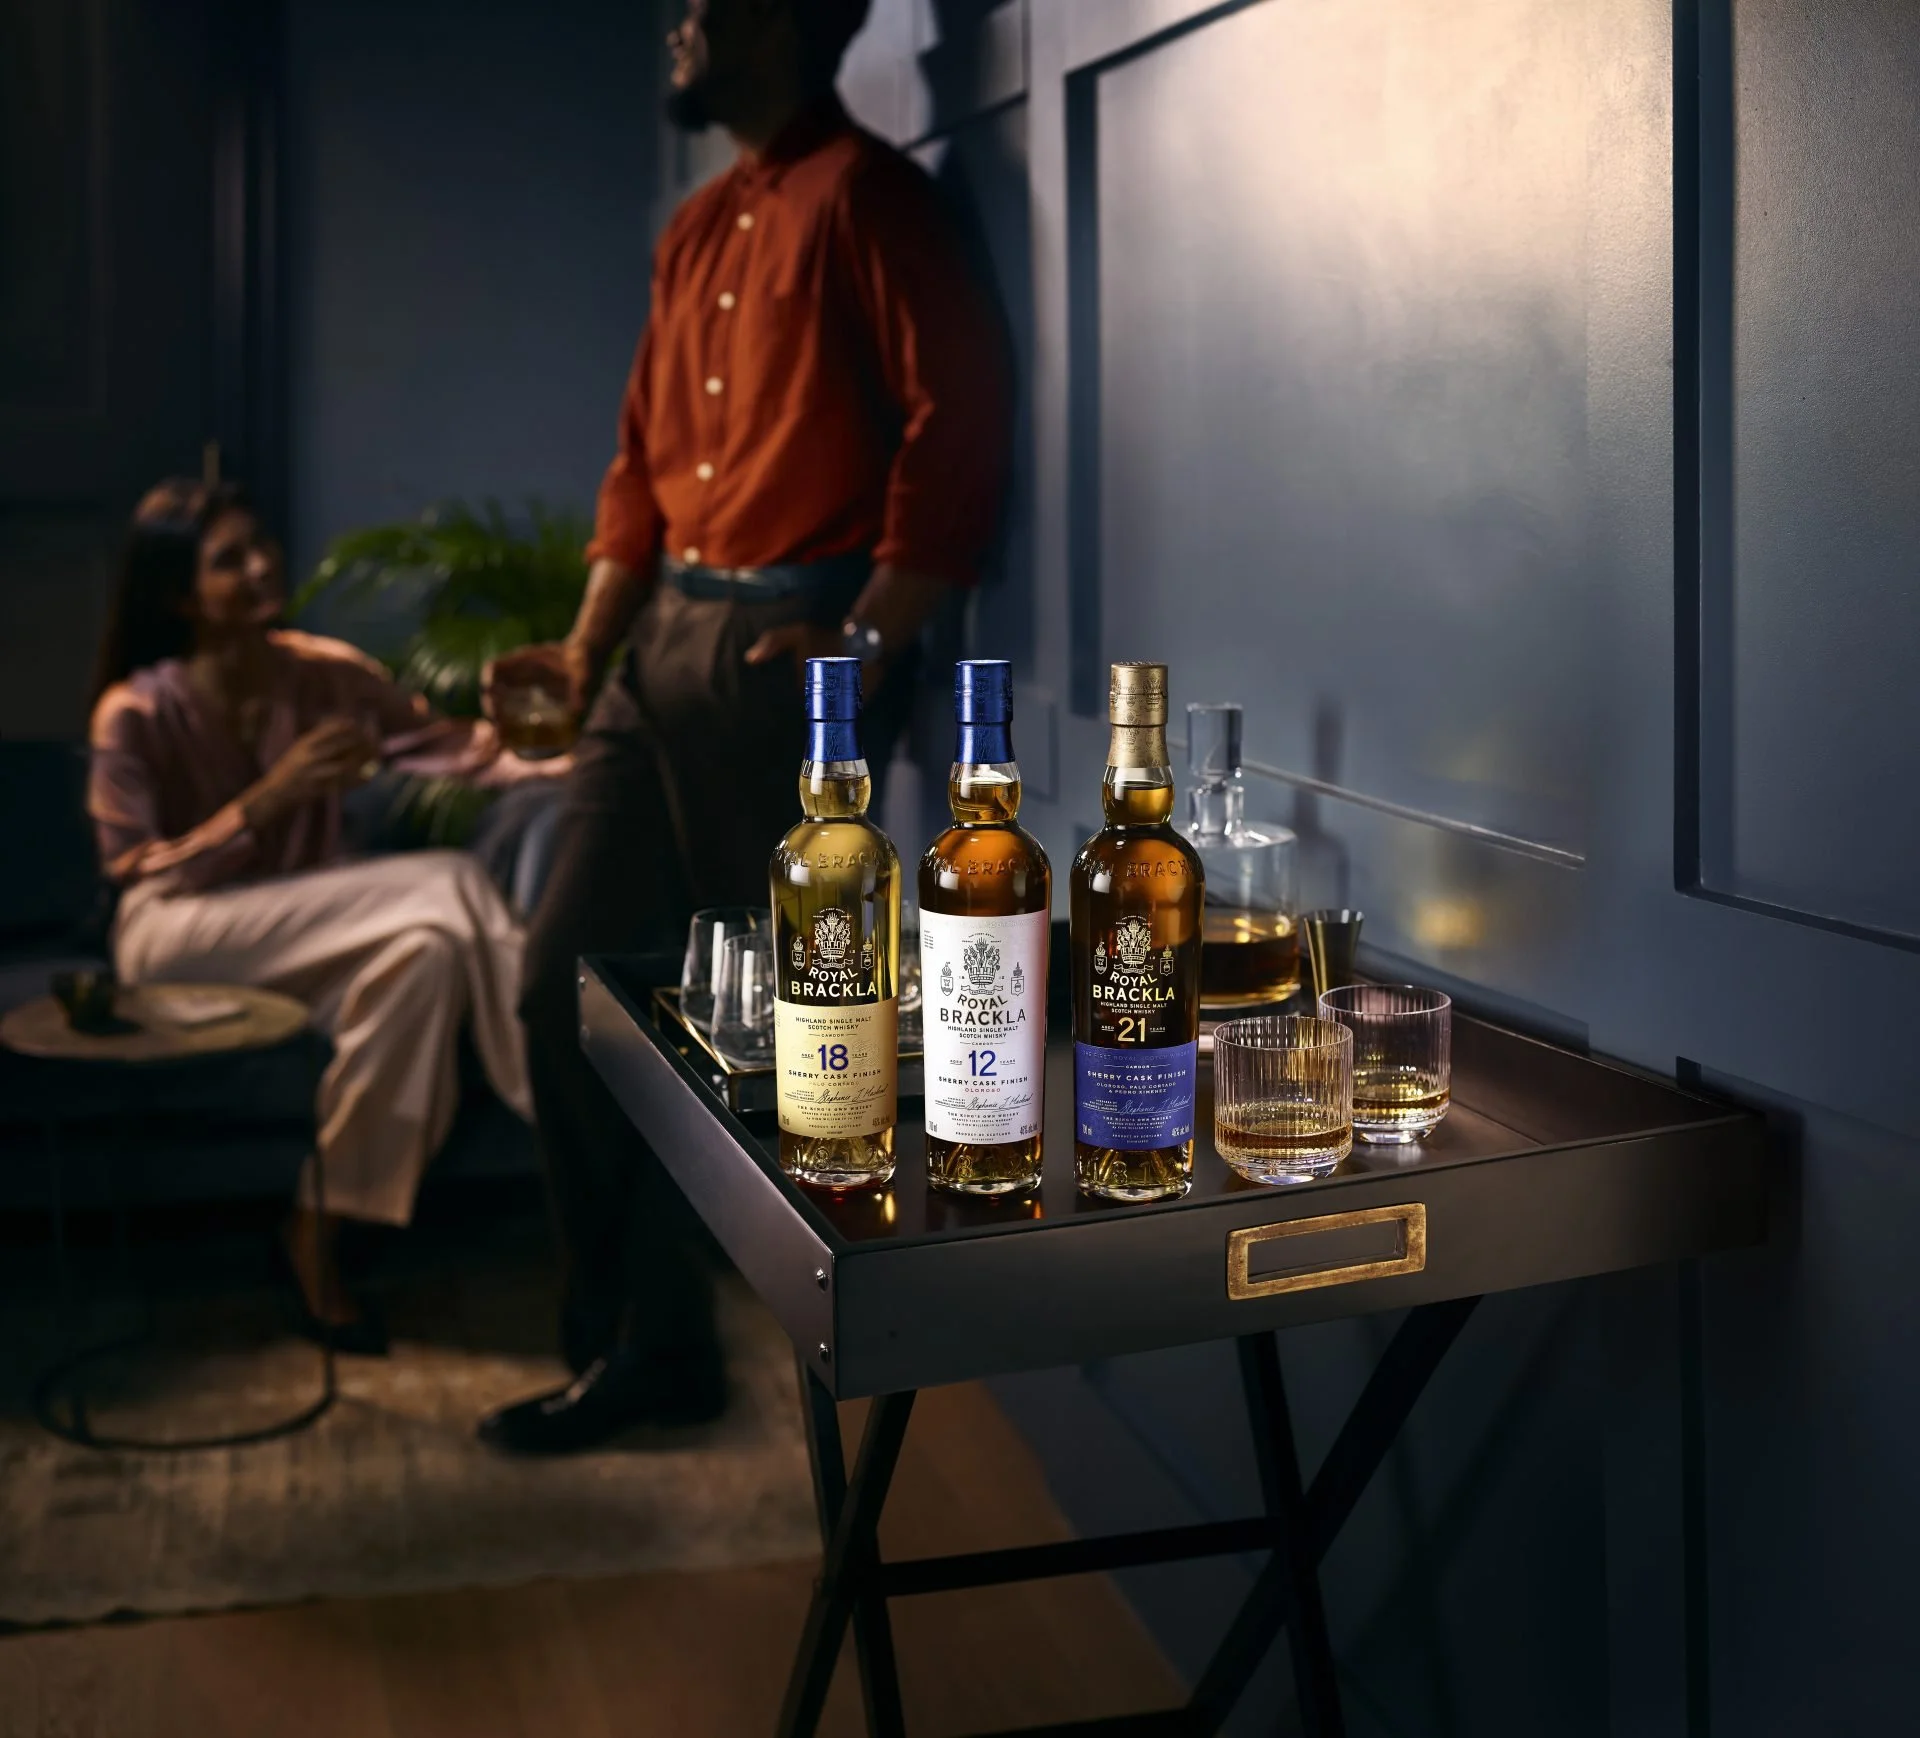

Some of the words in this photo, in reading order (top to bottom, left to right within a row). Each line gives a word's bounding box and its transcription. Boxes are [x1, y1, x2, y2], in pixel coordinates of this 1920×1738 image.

[808, 966, 858, 982] ROYAL
[1109, 971, 1158, 987] ROYAL
[791, 981, 877, 998] BRACKLA
[1092, 984, 1175, 1002] BRACKLA
[957, 994, 1008, 1010] ROYAL
[795, 1016, 827, 1024] HIGHLAND
[940, 1007, 1026, 1026] BRACKLA
[947, 1025, 977, 1033] HIGHLAND
[1117, 1016, 1146, 1042] 21
[818, 1044, 849, 1071] 18
[968, 1050, 997, 1077] 12
[788, 1069, 820, 1079] SHERRY
[853, 1069, 881, 1079] FINISH
[938, 1076, 969, 1085] SHERRY
[1001, 1076, 1028, 1085] FINISH
[1087, 1070, 1122, 1081] SHERRY
[1157, 1070, 1186, 1080] FINISH
